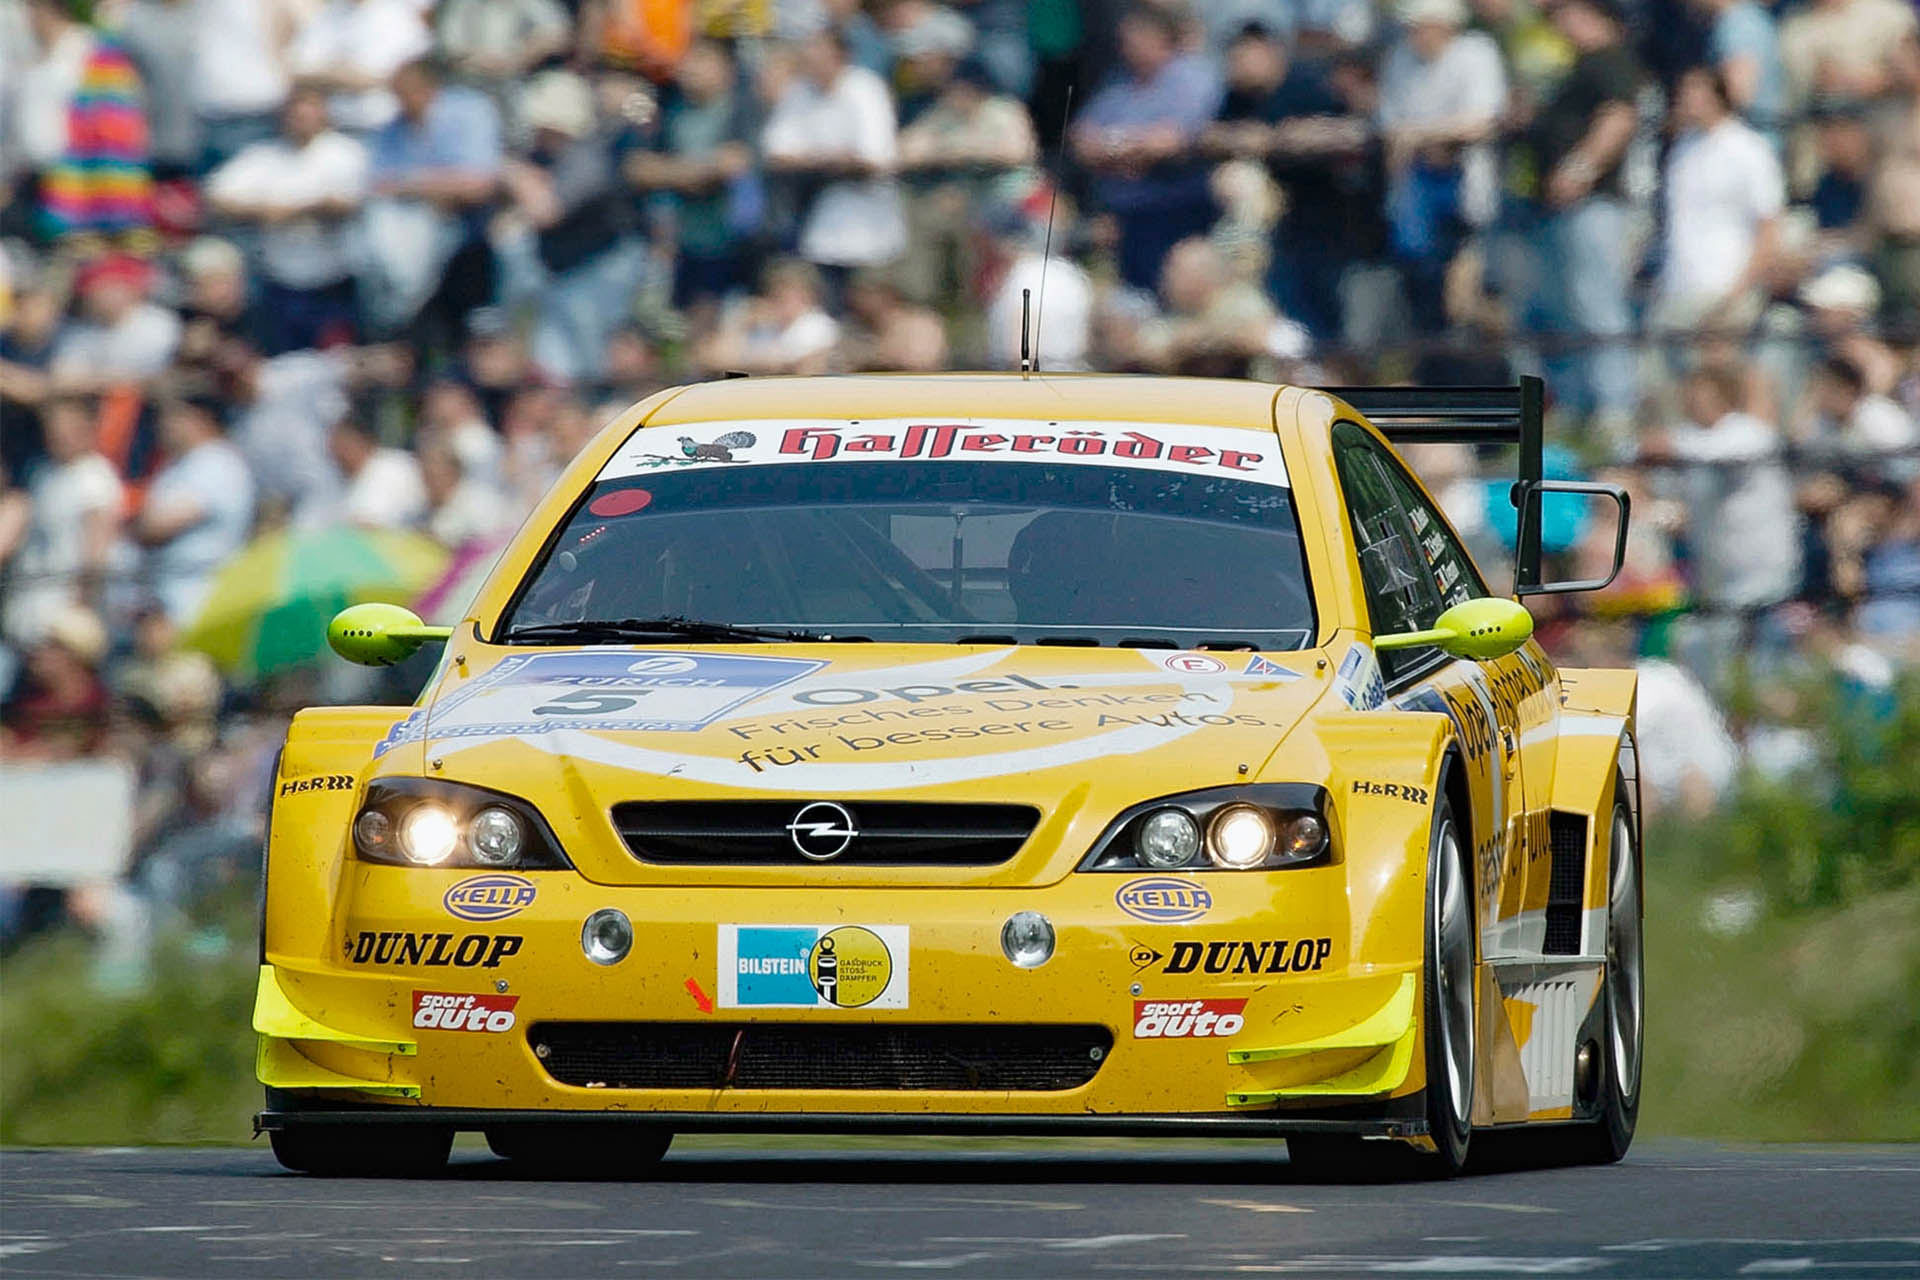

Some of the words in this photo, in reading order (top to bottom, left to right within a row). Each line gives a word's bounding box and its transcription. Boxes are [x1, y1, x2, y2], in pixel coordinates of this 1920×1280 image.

[532, 689, 653, 715] 5
[729, 702, 972, 740] Frisches
[989, 689, 1218, 712] Denken
[738, 743, 822, 773] für
[838, 716, 1073, 752] bessere
[1097, 711, 1283, 728] Autos.
[281, 778, 324, 796] H&R
[1353, 780, 1398, 797] H&R
[451, 887, 534, 906] HELLA
[1123, 891, 1212, 909] HELLA
[353, 932, 523, 967] DUNLOP
[1163, 939, 1331, 974] DUNLOP
[738, 958, 805, 974] BILSTEIN
[419, 995, 475, 1009] sport
[1142, 1001, 1204, 1016] sport
[414, 1006, 516, 1032] auto
[1134, 1010, 1244, 1037] auto
